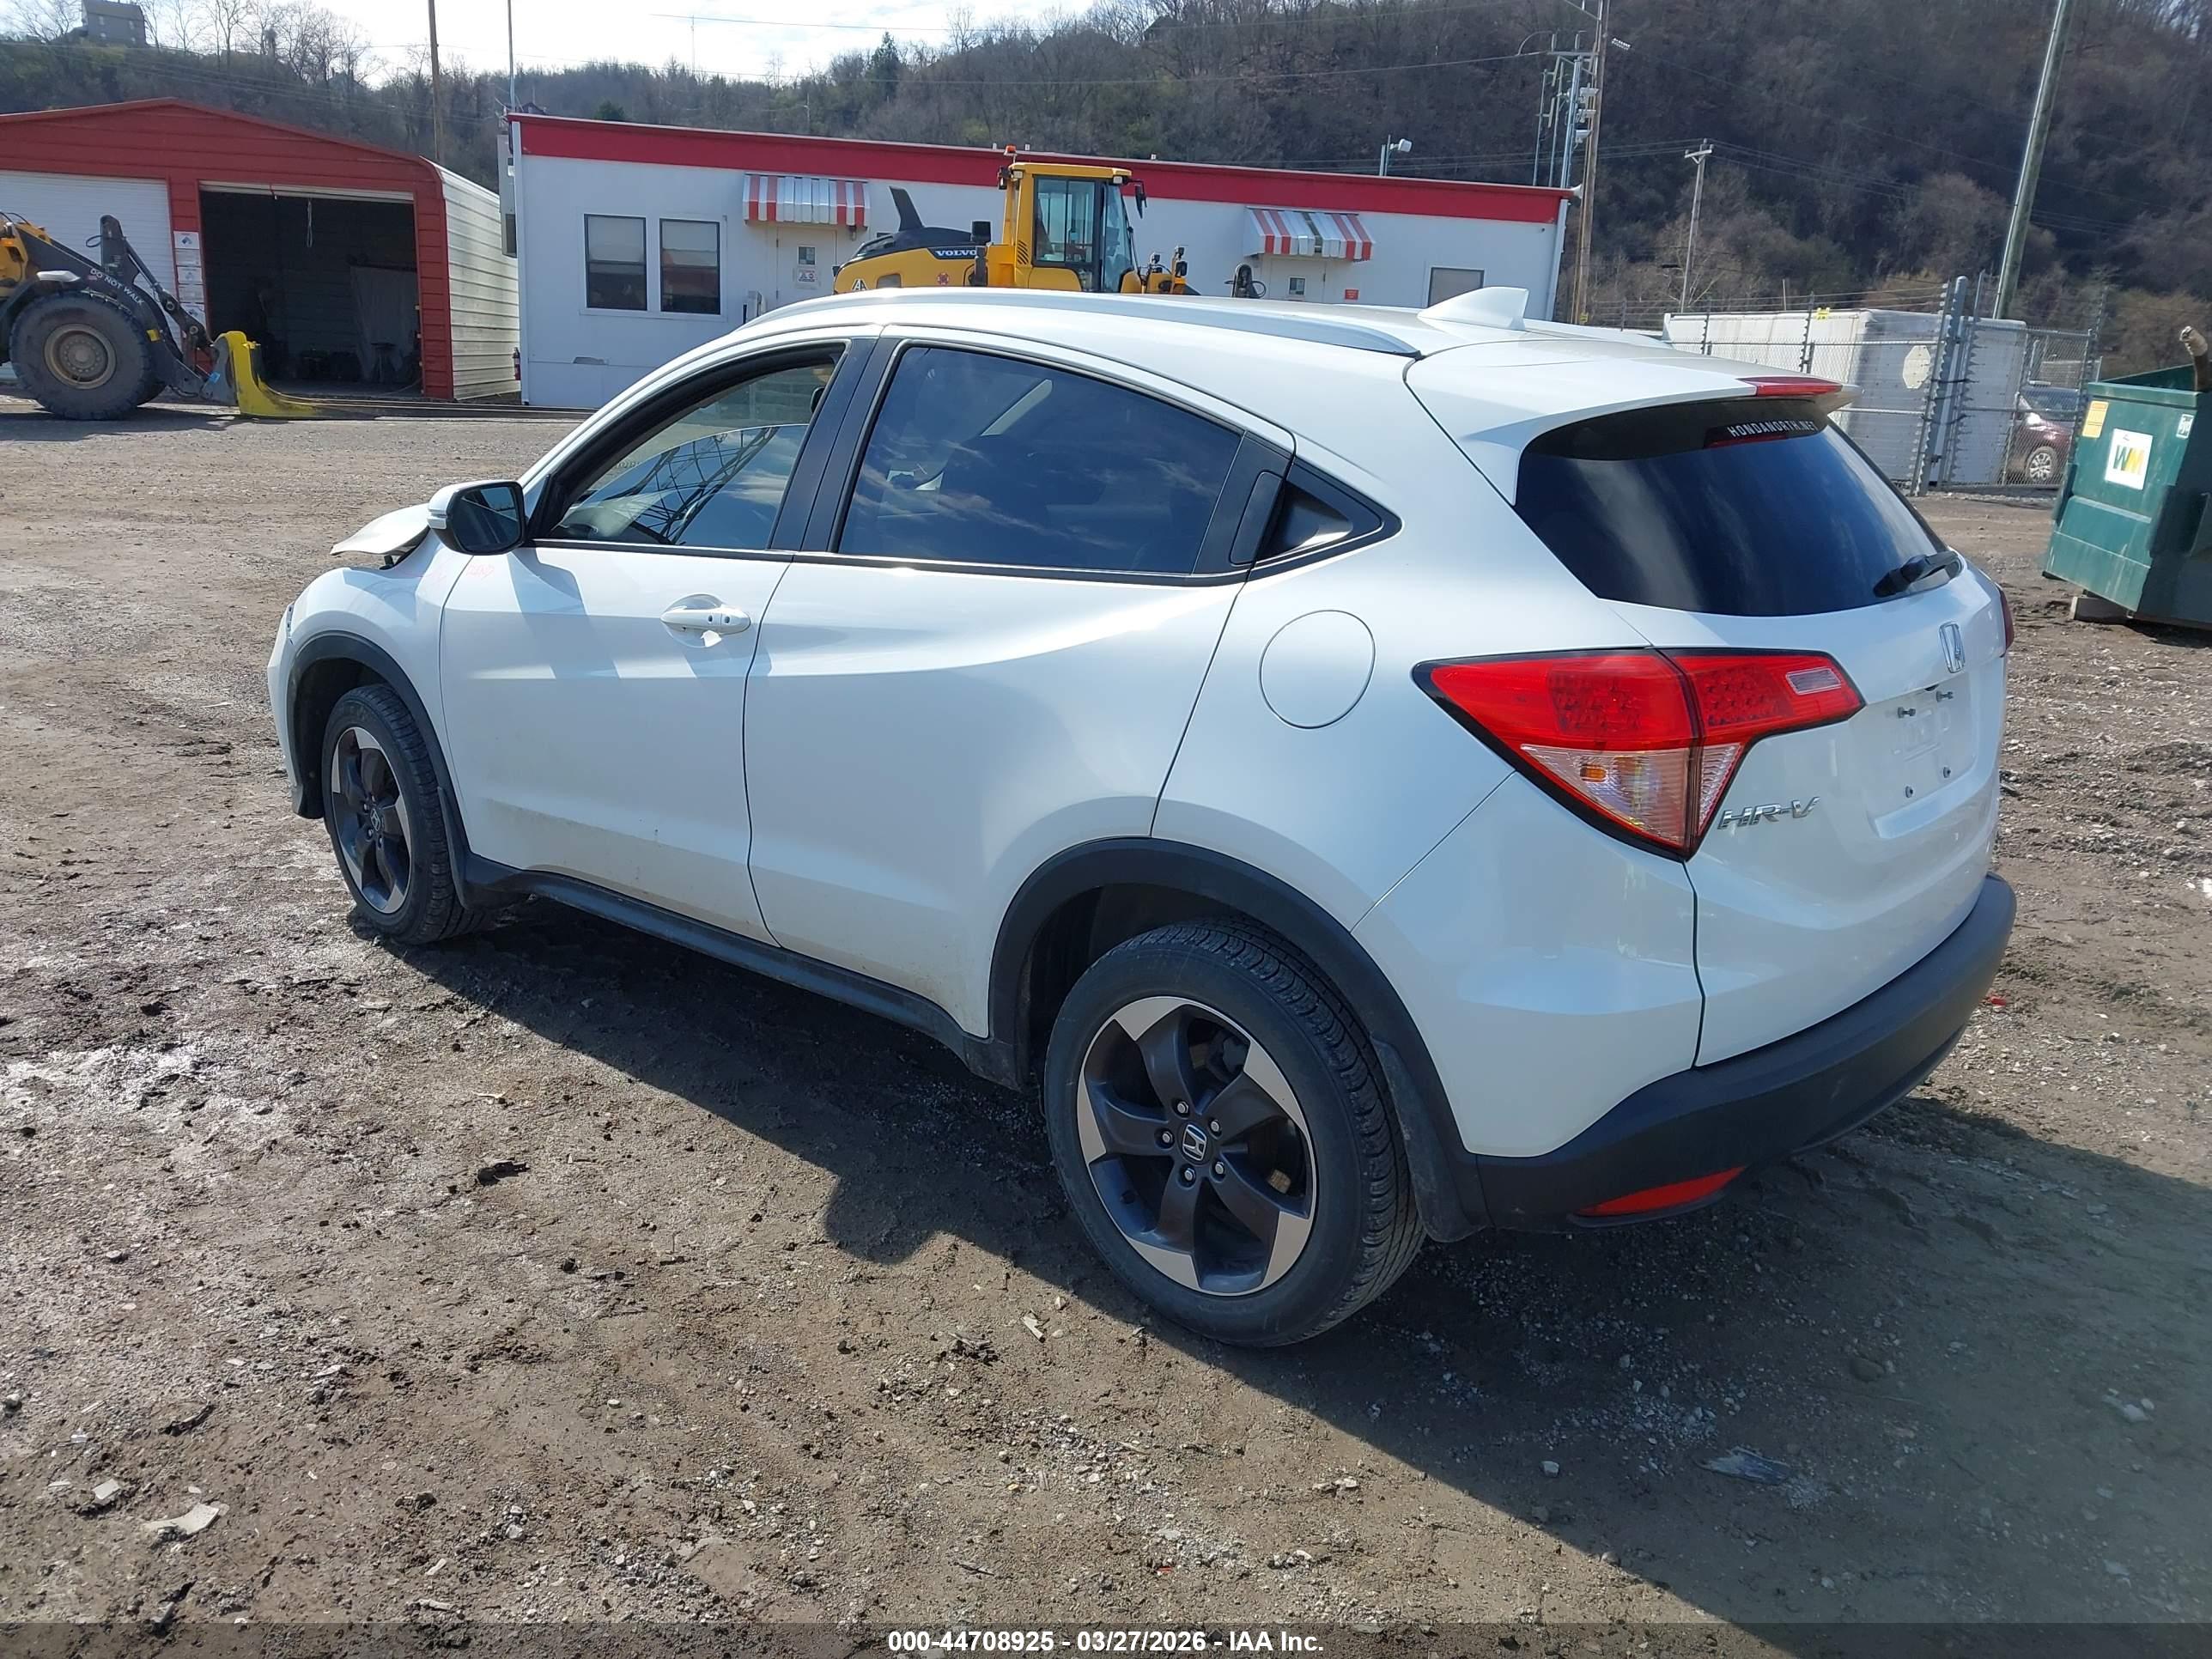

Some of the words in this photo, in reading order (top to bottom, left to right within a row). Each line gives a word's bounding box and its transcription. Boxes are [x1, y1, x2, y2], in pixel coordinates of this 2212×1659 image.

[90, 268, 103, 278] DO
[104, 276, 122, 289] NOT
[124, 287, 144, 305] WALK
[2112, 445, 2145, 475] WM
[1717, 797, 1820, 830] HR-V
